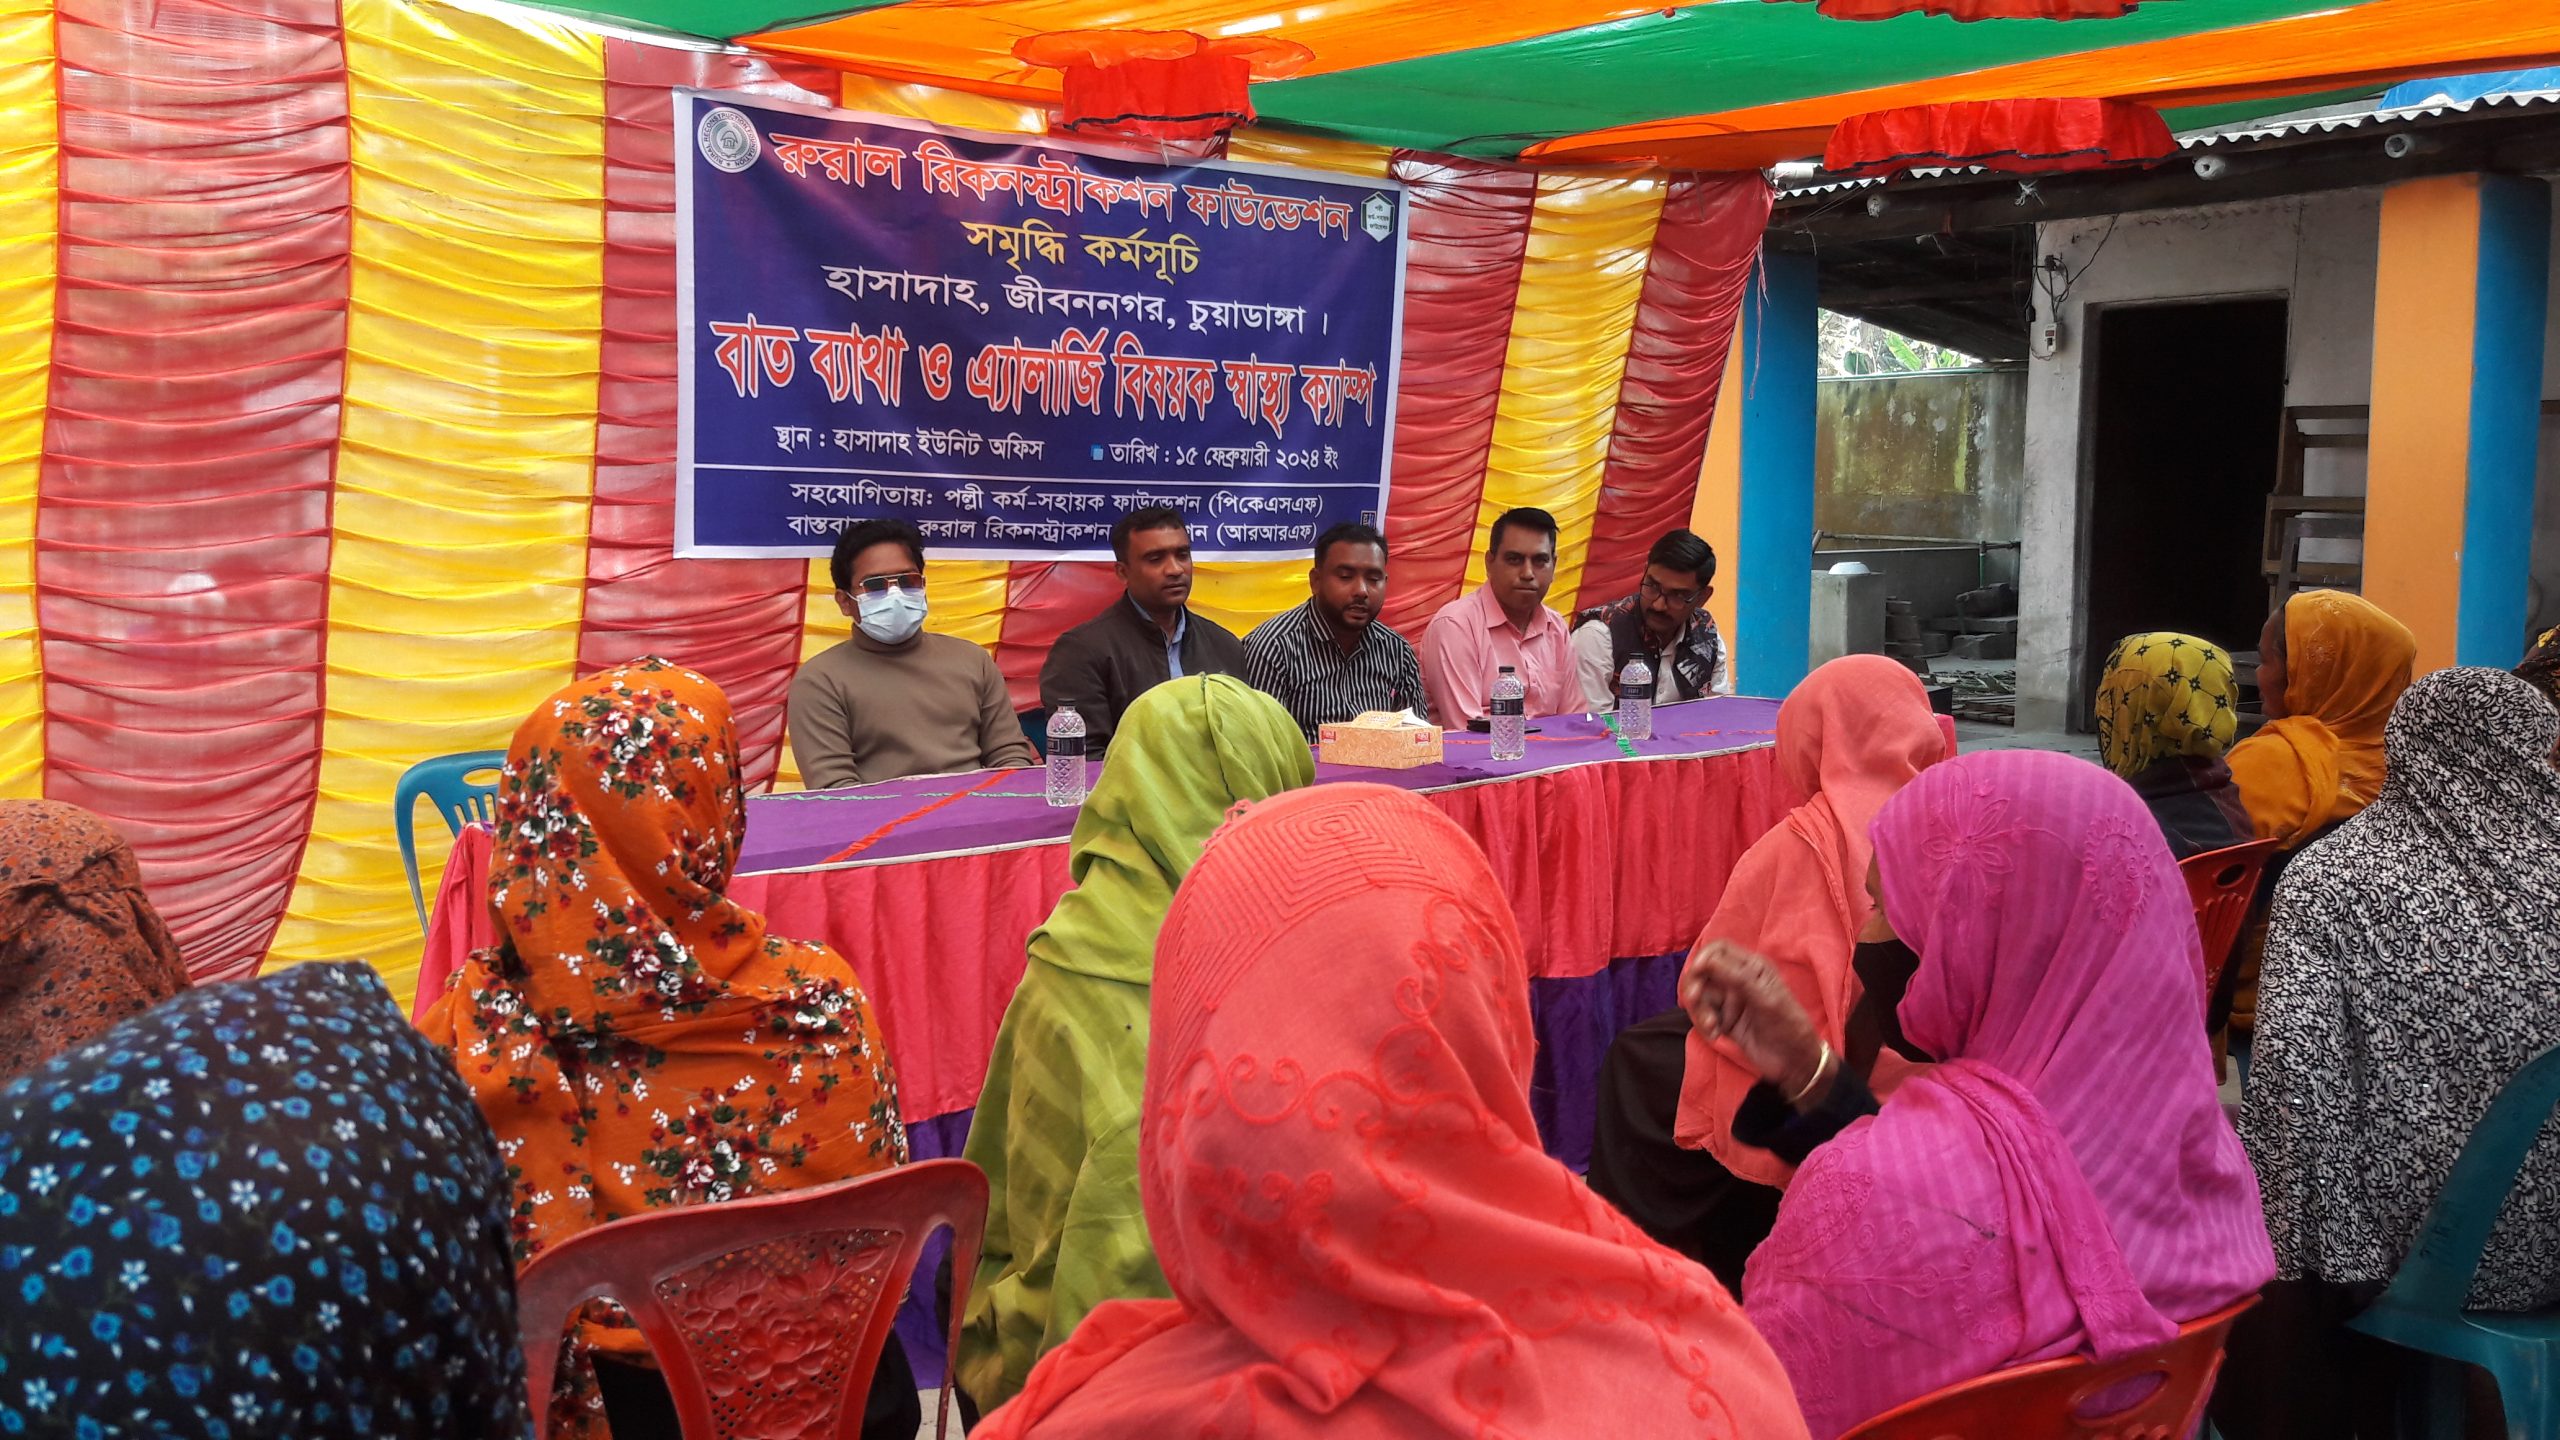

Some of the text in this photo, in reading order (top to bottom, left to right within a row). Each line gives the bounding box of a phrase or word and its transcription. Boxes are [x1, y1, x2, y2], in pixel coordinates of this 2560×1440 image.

[769, 133, 1353, 241] রুরাল রিকনস্ট্রাকশন ফাউন্ডেশন
[961, 218, 1201, 285] সমৃদ্ধি কর্মসূচি
[821, 265, 990, 314] হাসাদাহ,
[1001, 275, 1176, 330] জীবননগর,
[1187, 299, 1306, 335] চুয়াডাঙ্গা
[709, 313, 1377, 440] বাত ব্যাথা ও এ্যালার্জি বিষয়ক স্বাস্থ্য ক্যাম্প
[773, 425, 812, 454] স্থান
[832, 429, 912, 455] হাসাদাহ
[916, 426, 983, 457] ইউনিট
[989, 432, 1044, 461] অফিস
[1109, 437, 1158, 465] তারিখ
[1176, 449, 1198, 466] ১৫
[1204, 444, 1270, 469] ফেব্রুয়ারী
[1275, 448, 1319, 469] ২০২৪
[1324, 445, 1339, 470] ইং
[789, 479, 1323, 518] সহযোগিতায়: পল্লী কর্ম-সহায়ক ফাউন্ডেশন (পিকেএসএফ)
[917, 518, 977, 538] রুরাল
[984, 516, 1112, 543] রিকনস্ট্রাকশন
[1217, 522, 1317, 547] (আরআরএফ)
